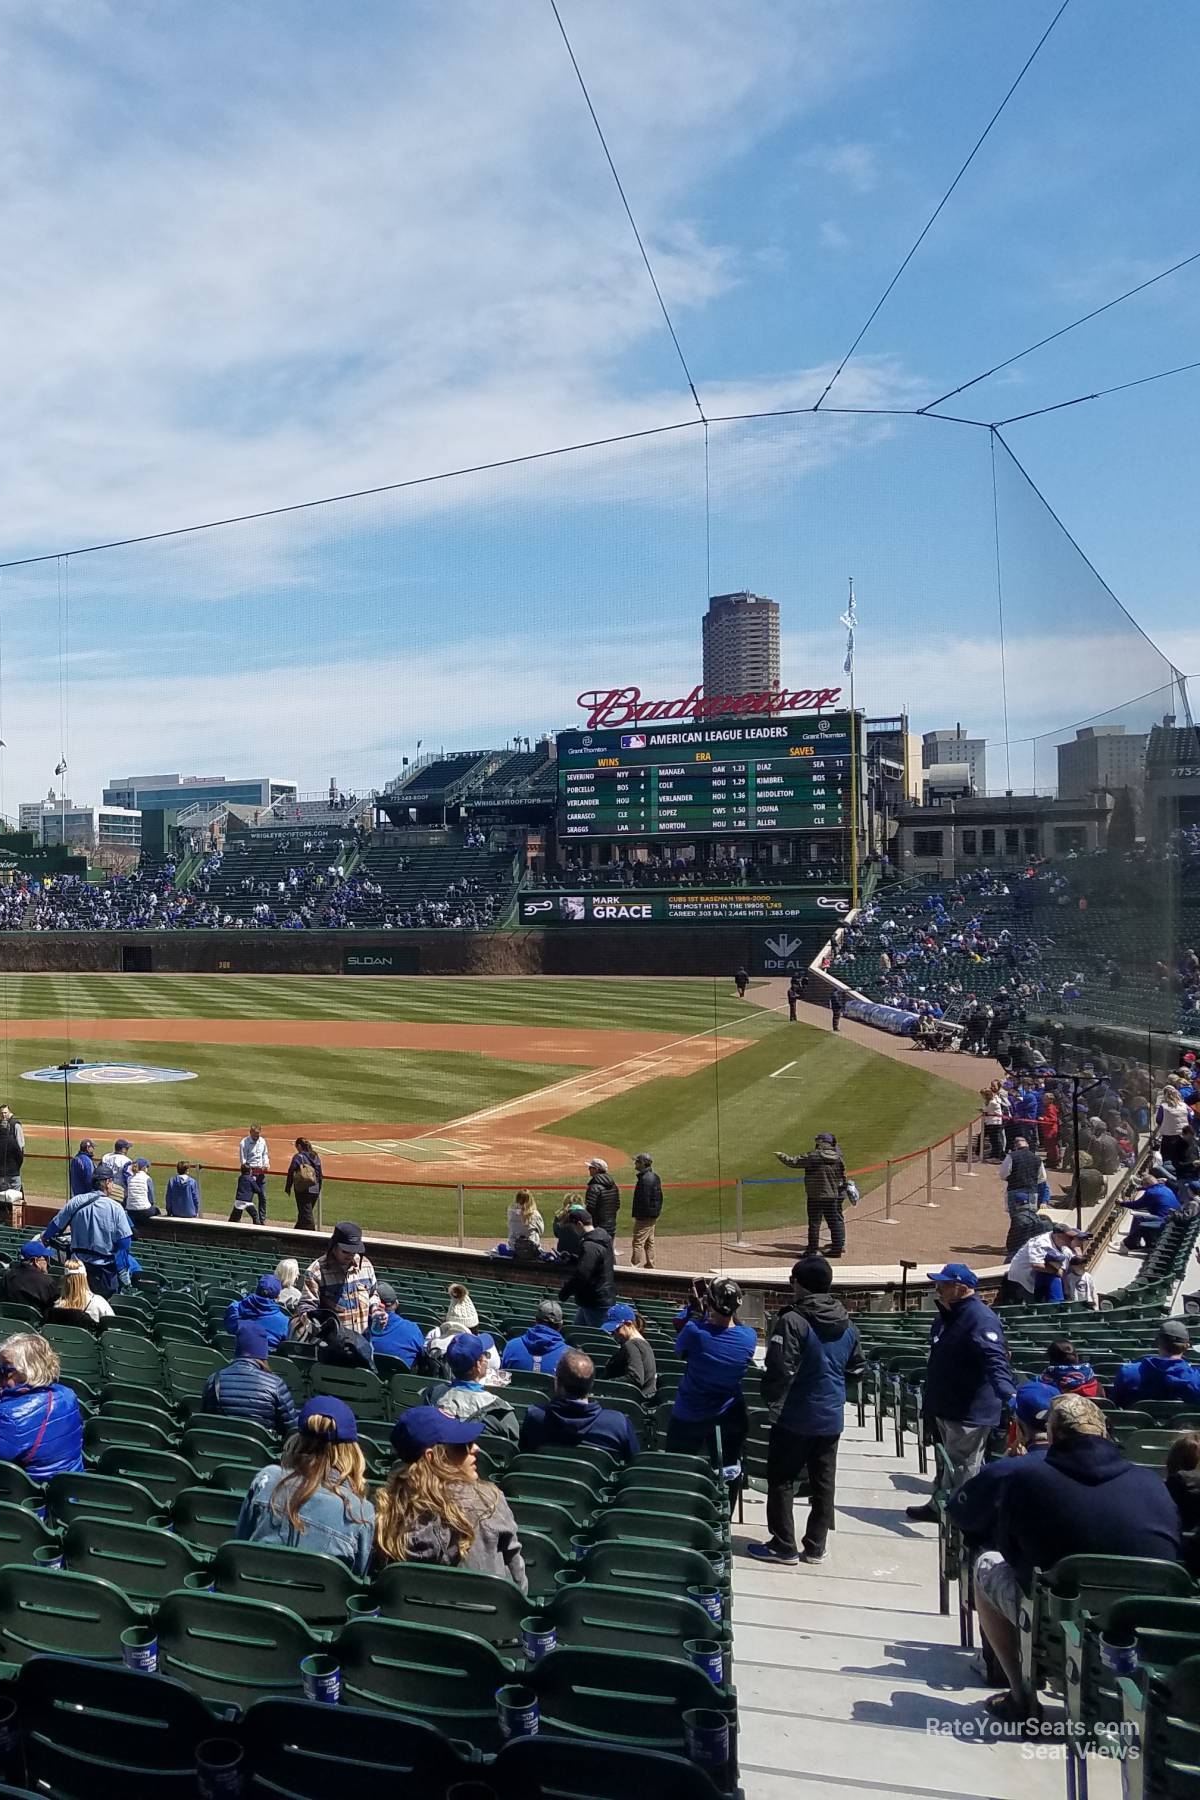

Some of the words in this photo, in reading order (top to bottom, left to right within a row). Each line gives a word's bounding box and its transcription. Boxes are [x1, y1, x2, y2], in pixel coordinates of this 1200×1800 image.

[577, 678, 842, 729] Budweiser
[650, 732, 703, 745] AMERICAN
[705, 729, 743, 742] LEAGUE
[745, 726, 788, 739] LEADERS
[789, 746, 815, 756] SAVES
[695, 752, 711, 761] ERA
[598, 758, 619, 767] WINS
[756, 763, 772, 771] DIAZ
[812, 760, 825, 768] SEA
[835, 759, 844, 767] 11
[659, 768, 685, 776] MANAEA
[712, 765, 726, 773] OAK
[732, 764, 745, 772] 1.23
[756, 776, 784, 784] KIMBREL
[812, 774, 825, 782] BOS
[659, 781, 674, 789] COLE
[659, 795, 693, 803] VERLANDER
[712, 792, 726, 800] HOU
[756, 790, 794, 798] MIDDLETON
[813, 788, 825, 796] LAA
[567, 799, 600, 807] VERLANDER
[616, 797, 630, 805] HOU
[659, 809, 678, 817] LOPEZ
[712, 807, 727, 815] CWS
[732, 806, 745, 814] 1.50
[756, 805, 779, 813] OSUNA
[813, 803, 826, 811] TOR
[659, 822, 686, 830] MORTON
[712, 820, 726, 828] HOU
[813, 817, 825, 825] CLE
[592, 896, 620, 904] MARK
[593, 905, 653, 918] GRACE
[347, 956, 392, 965] SLOAN
[764, 960, 802, 969] IDEAL
